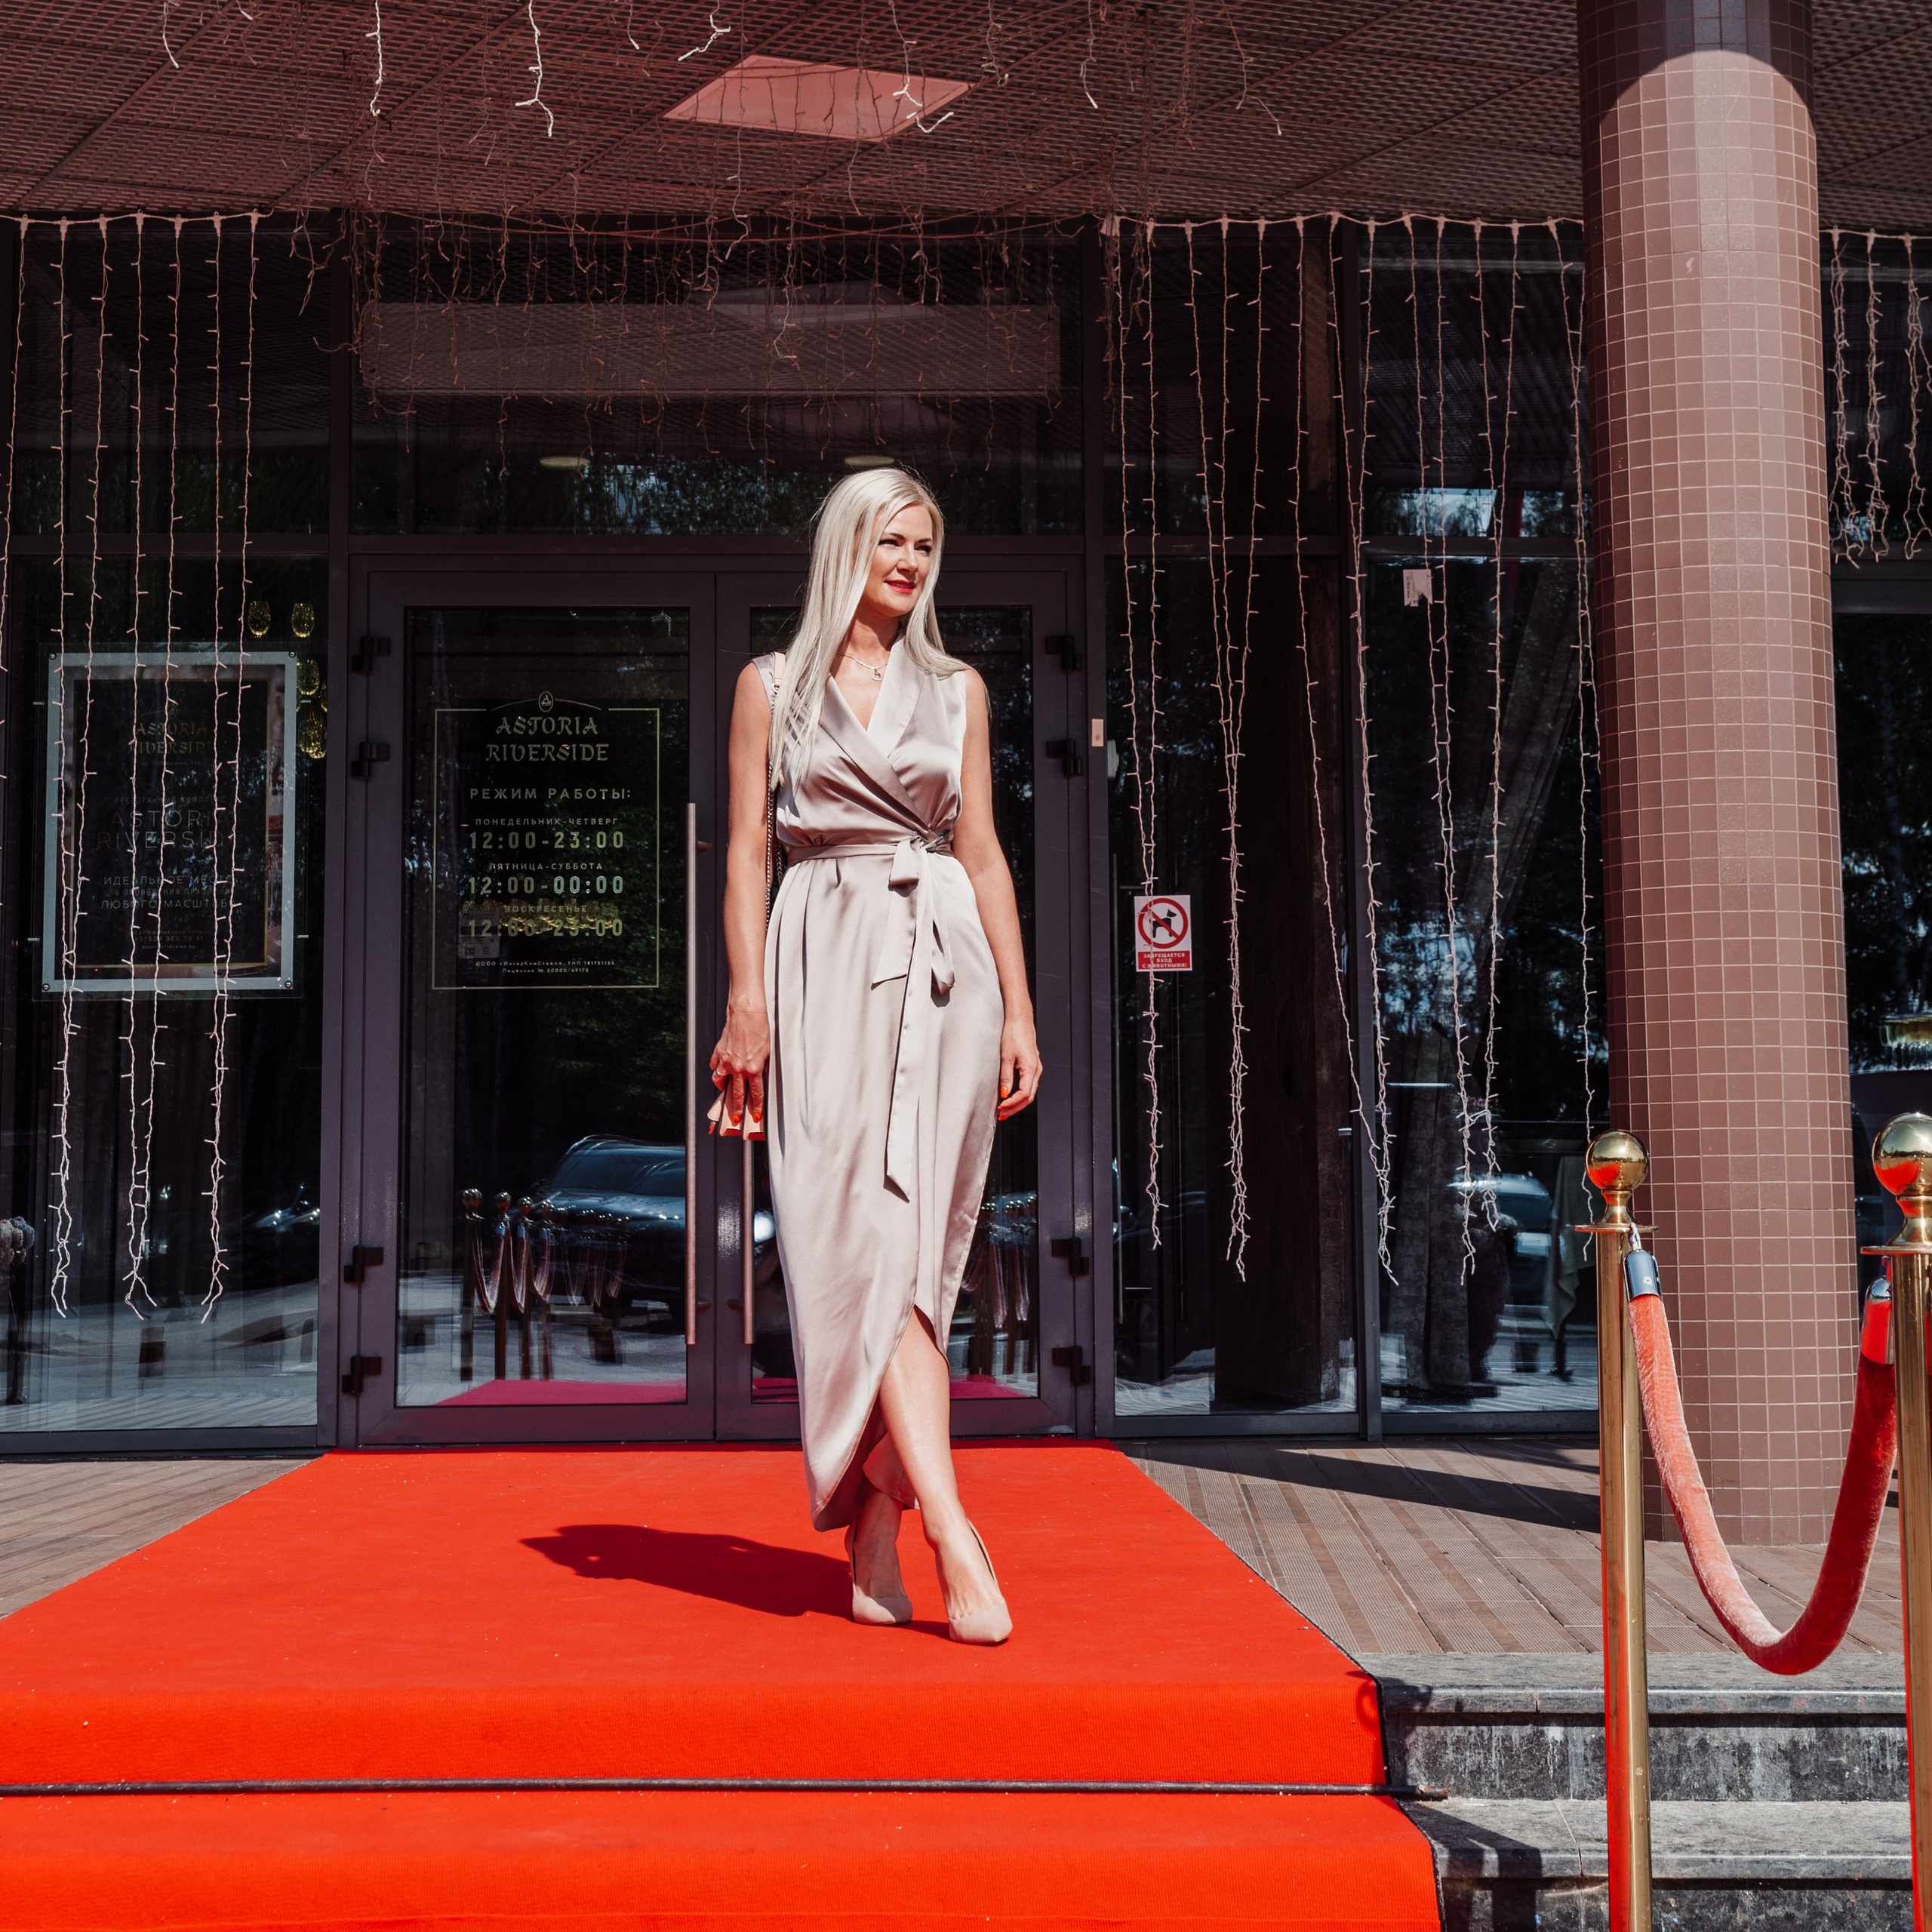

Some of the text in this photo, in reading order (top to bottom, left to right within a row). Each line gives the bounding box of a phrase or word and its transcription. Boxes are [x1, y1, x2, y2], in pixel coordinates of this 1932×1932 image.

[136, 722, 207, 735] ASTORIA
[496, 716, 599, 735] ASTORIA
[485, 743, 610, 762] RIVERSIDE
[469, 788, 631, 800] РЕЖИМ РАБОТЫ:
[111, 810, 229, 828] ASTORIA
[475, 818, 618, 827] ПОНЕДЕЛЬНИК-ЧЕТВЕРГ
[469, 831, 623, 850] 12:00-23:00
[490, 863, 603, 872] ПЯТНИЦА-СУББОТА
[468, 875, 624, 894] 12:00-00:00
[505, 905, 587, 913] ВОСКРЕСЕНЬЕ
